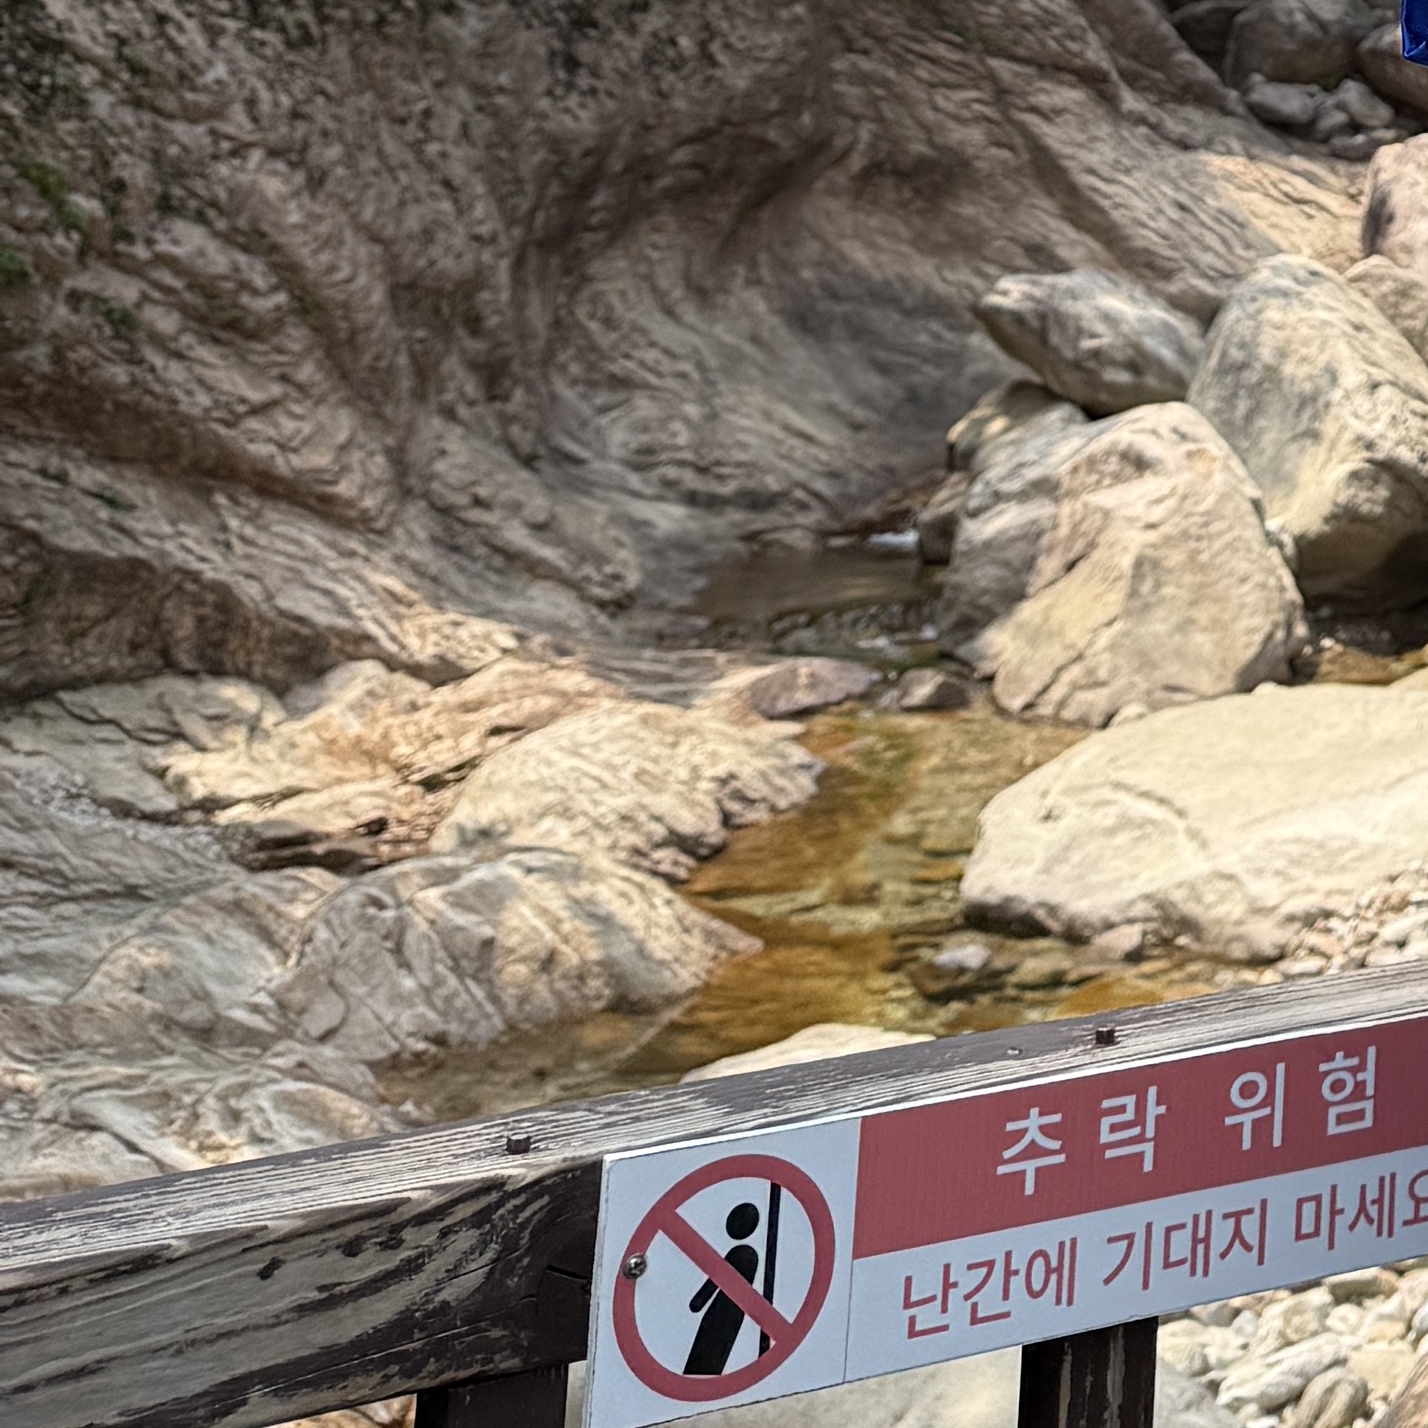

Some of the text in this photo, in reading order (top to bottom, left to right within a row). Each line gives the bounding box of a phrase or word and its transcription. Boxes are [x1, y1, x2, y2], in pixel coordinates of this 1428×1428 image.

[996, 1045, 1378, 1195] 추락 위험
[903, 1236, 1076, 1340] 난간에
[1102, 1198, 1267, 1295] 기대지
